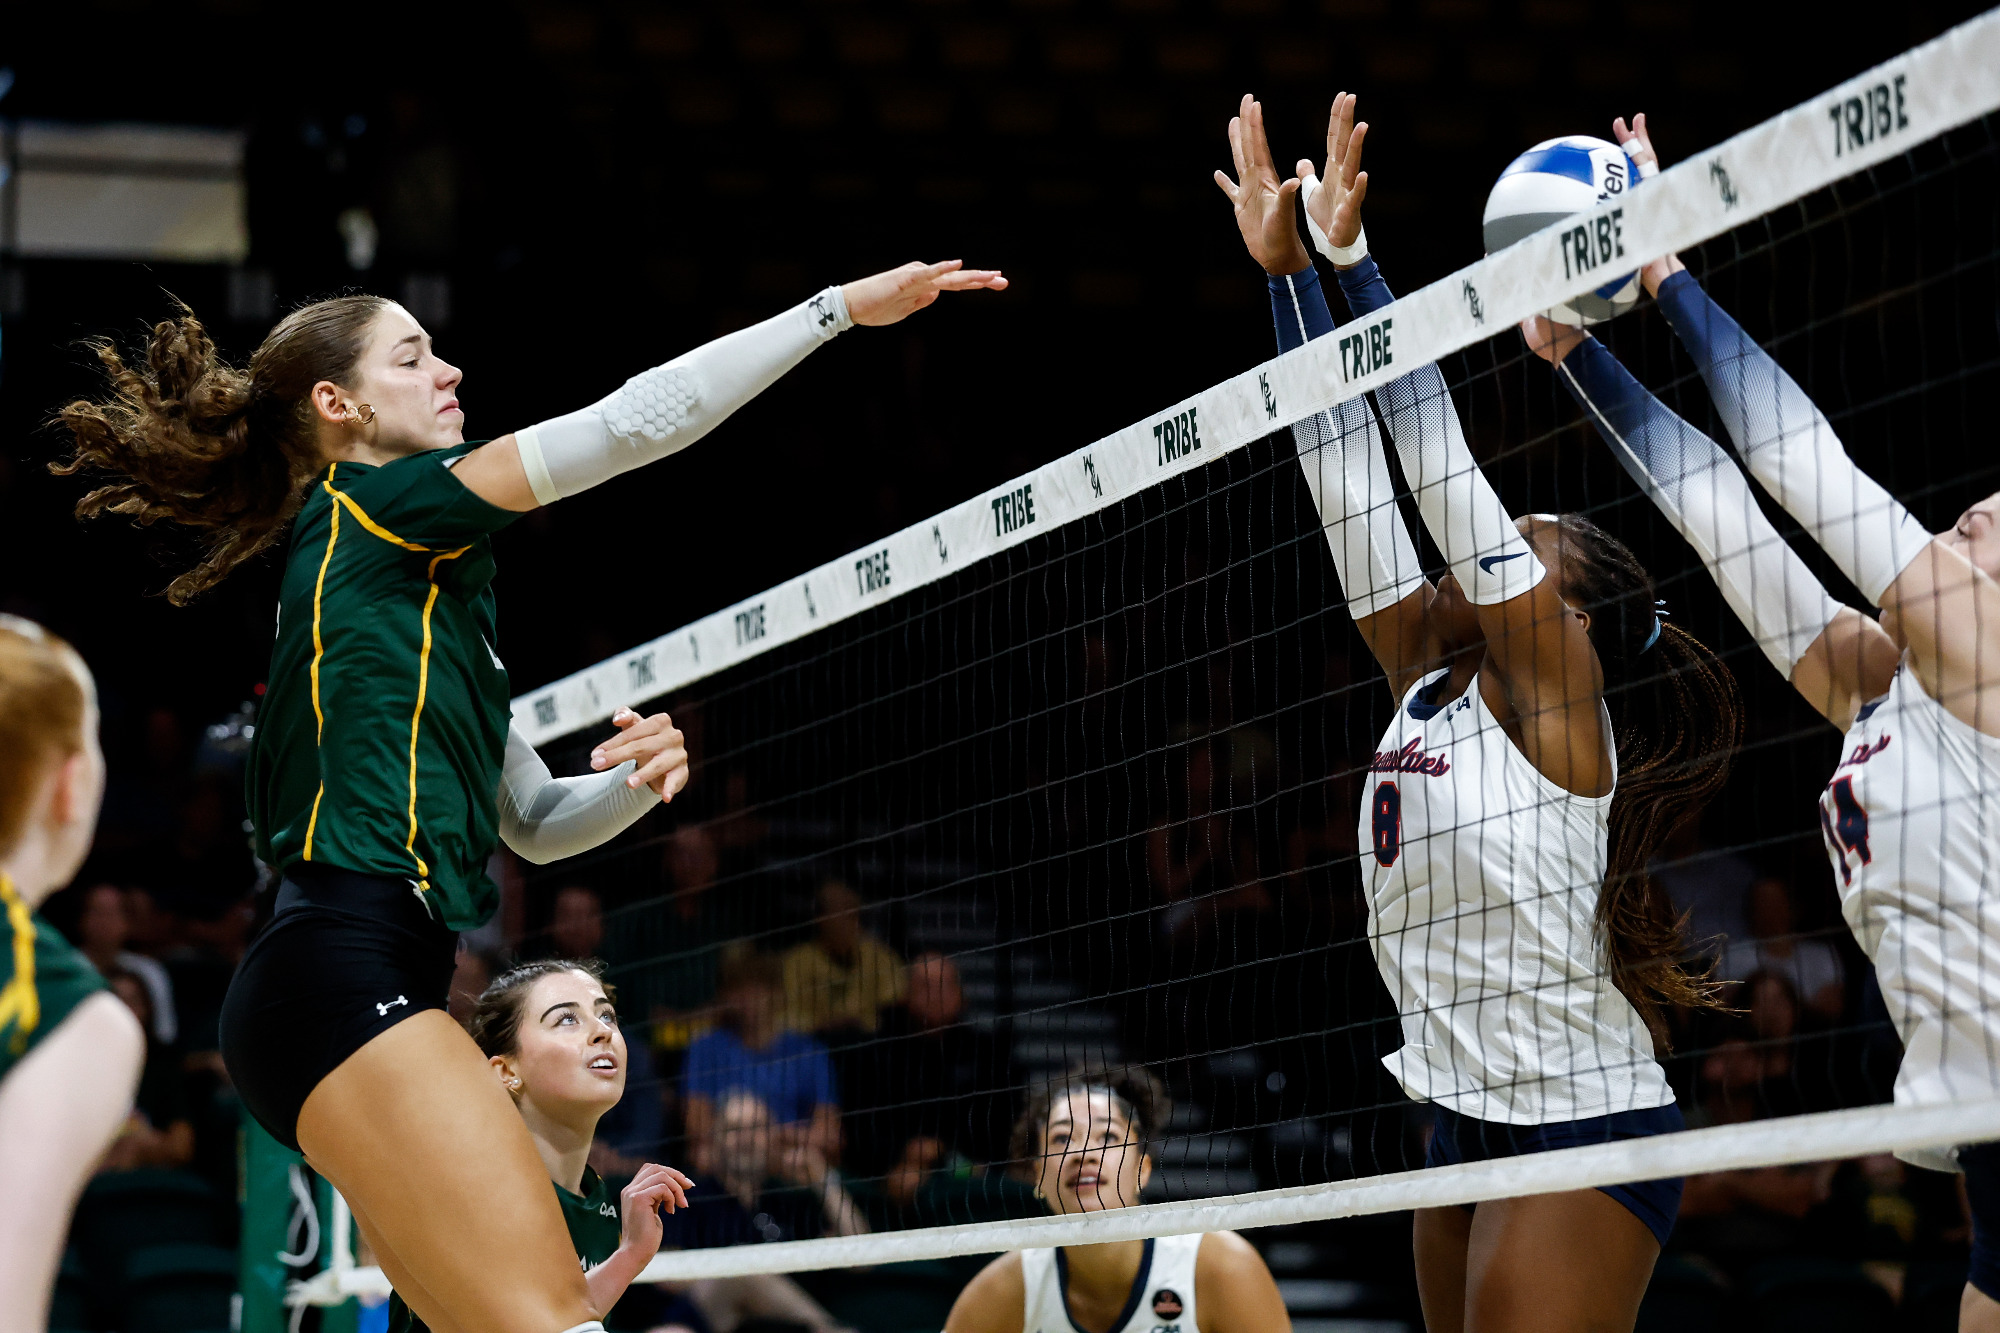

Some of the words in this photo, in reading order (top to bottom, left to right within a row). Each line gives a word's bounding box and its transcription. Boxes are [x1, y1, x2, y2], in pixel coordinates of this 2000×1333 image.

[1829, 74, 1909, 157] TRIBE
[1561, 207, 1624, 280] TRIBE
[1339, 318, 1393, 384] TRIBE
[1153, 406, 1202, 467] TRIBE
[991, 484, 1036, 537] TRIBE
[1372, 781, 1401, 867] 8
[1819, 774, 1872, 888] 14
